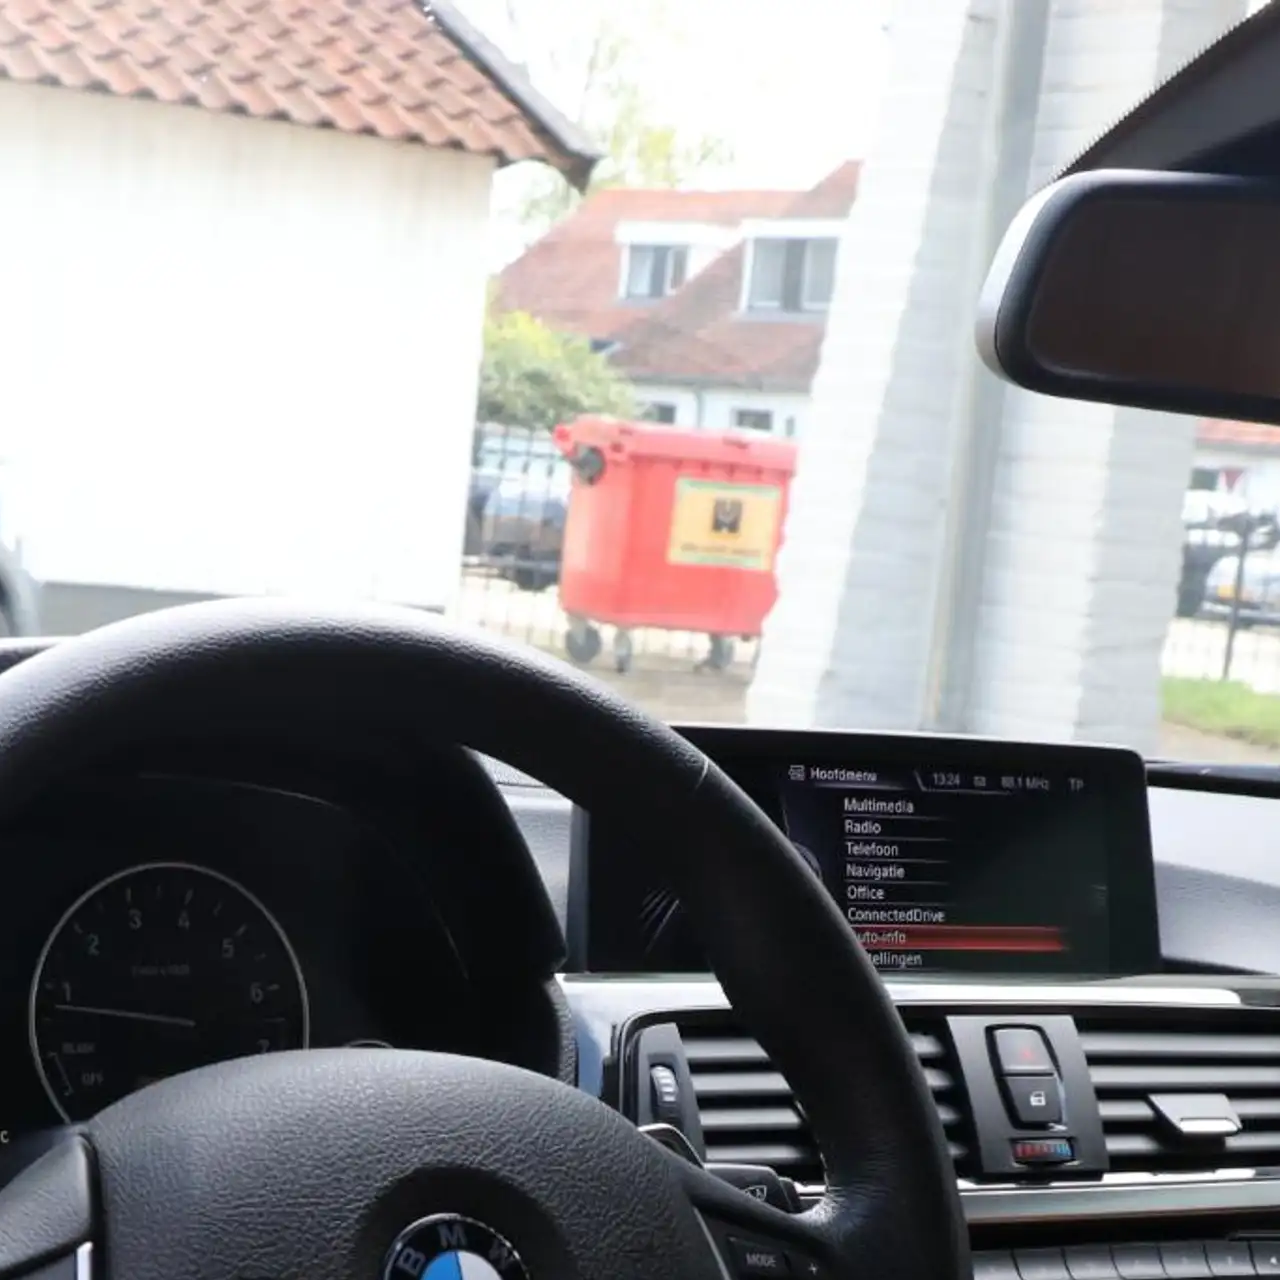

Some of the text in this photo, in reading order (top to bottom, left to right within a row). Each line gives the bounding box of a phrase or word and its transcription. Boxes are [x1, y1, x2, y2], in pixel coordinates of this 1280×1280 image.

[810, 767, 877, 783] Hoofdmenu
[844, 797, 914, 814] Multimedia
[845, 820, 881, 834] Radio
[846, 842, 899, 857] Telefoon
[846, 863, 905, 880] Navigatie
[847, 885, 885, 900] Office
[848, 907, 945, 922] ConnectedDrive
[855, 930, 907, 944] uto-info
[867, 952, 923, 968] tellingen
[395, 1223, 516, 1276] BMW
[745, 1251, 777, 1268] MODE
